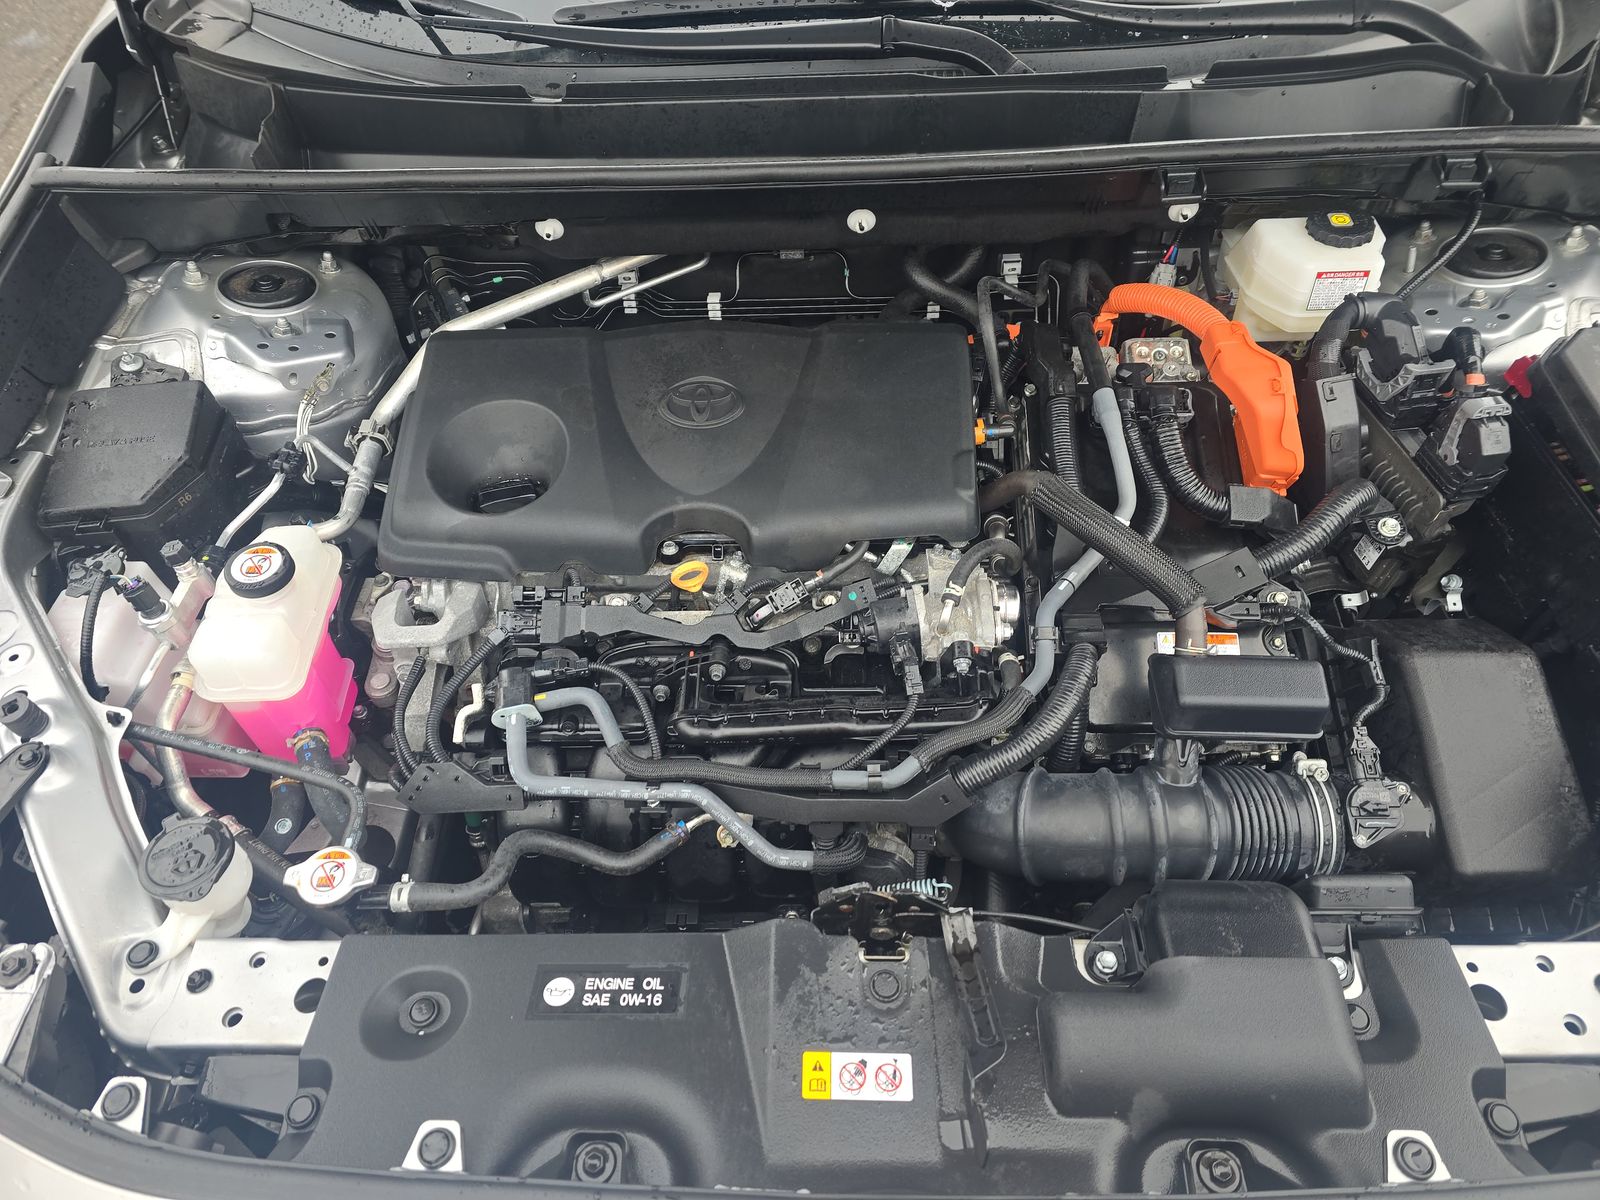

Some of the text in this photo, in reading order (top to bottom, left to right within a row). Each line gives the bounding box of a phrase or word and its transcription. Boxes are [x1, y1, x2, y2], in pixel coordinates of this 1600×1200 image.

[178, 492, 193, 507] R6
[585, 977, 664, 990] ENGINE OIL
[582, 993, 662, 1006] SAE 0W-16
